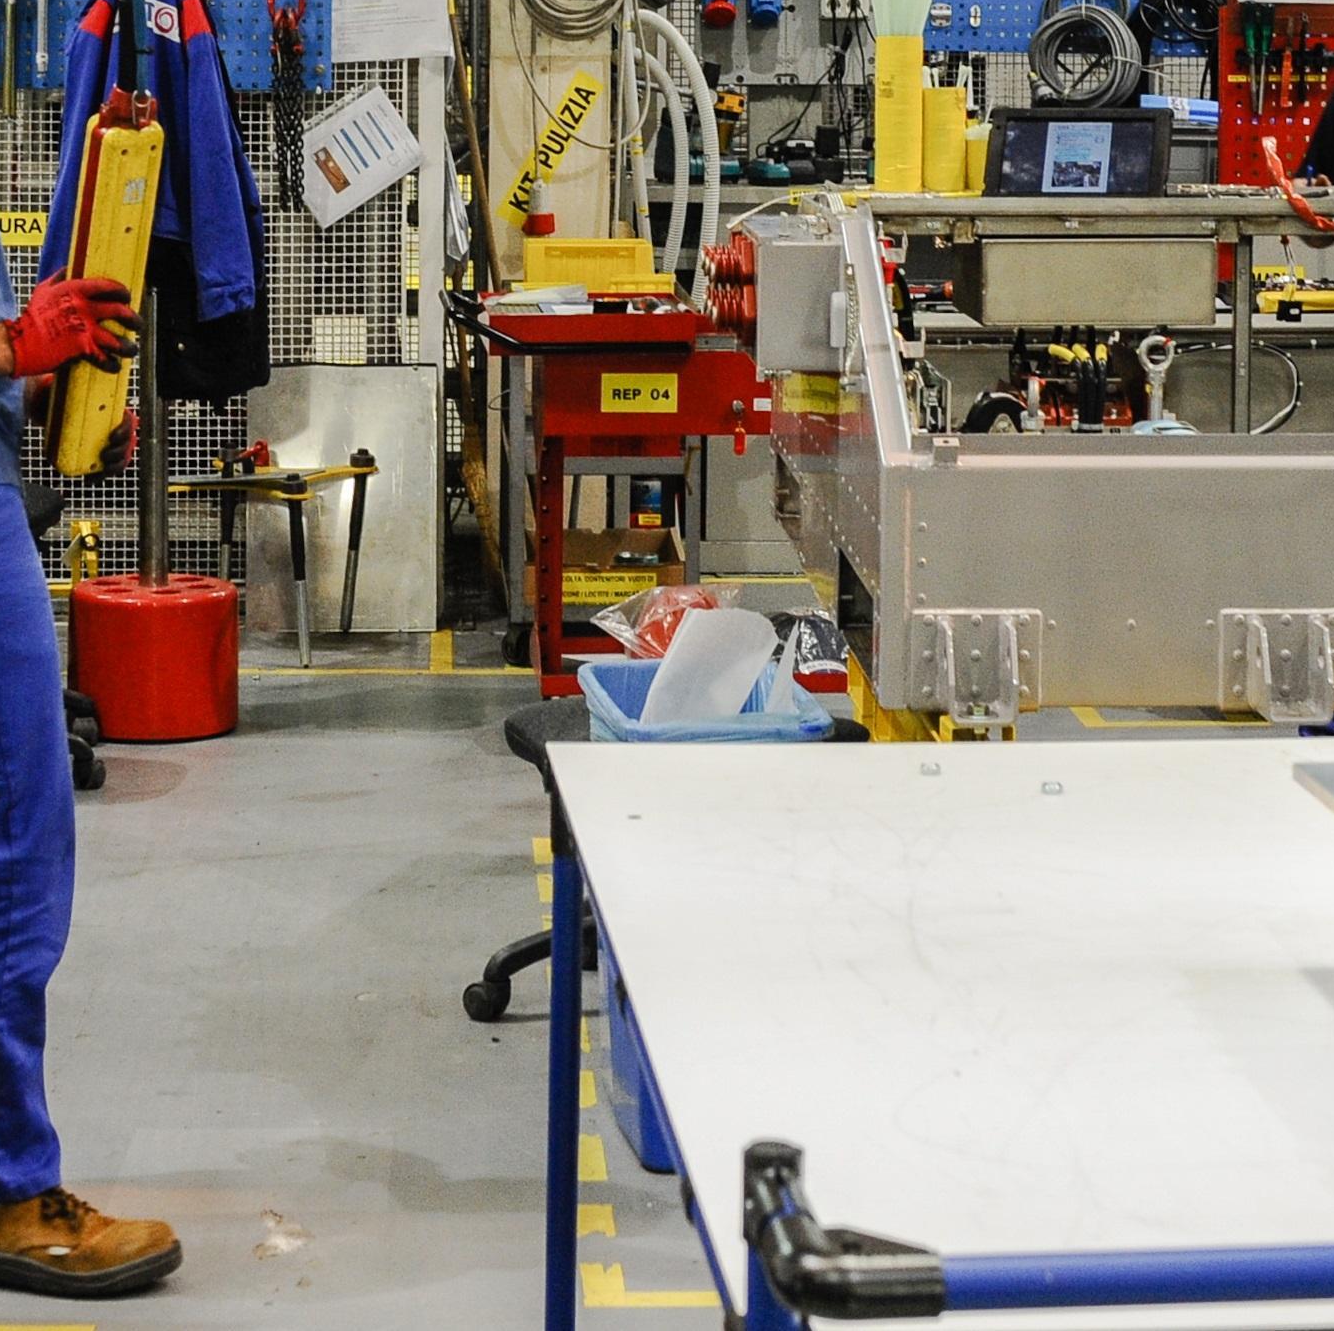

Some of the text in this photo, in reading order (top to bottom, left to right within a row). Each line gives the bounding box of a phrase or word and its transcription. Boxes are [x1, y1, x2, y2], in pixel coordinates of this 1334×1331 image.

[509, 87, 596, 213] KIT PULIZIA
[0, 218, 43, 234] URA
[612, 388, 670, 400] REP 04
